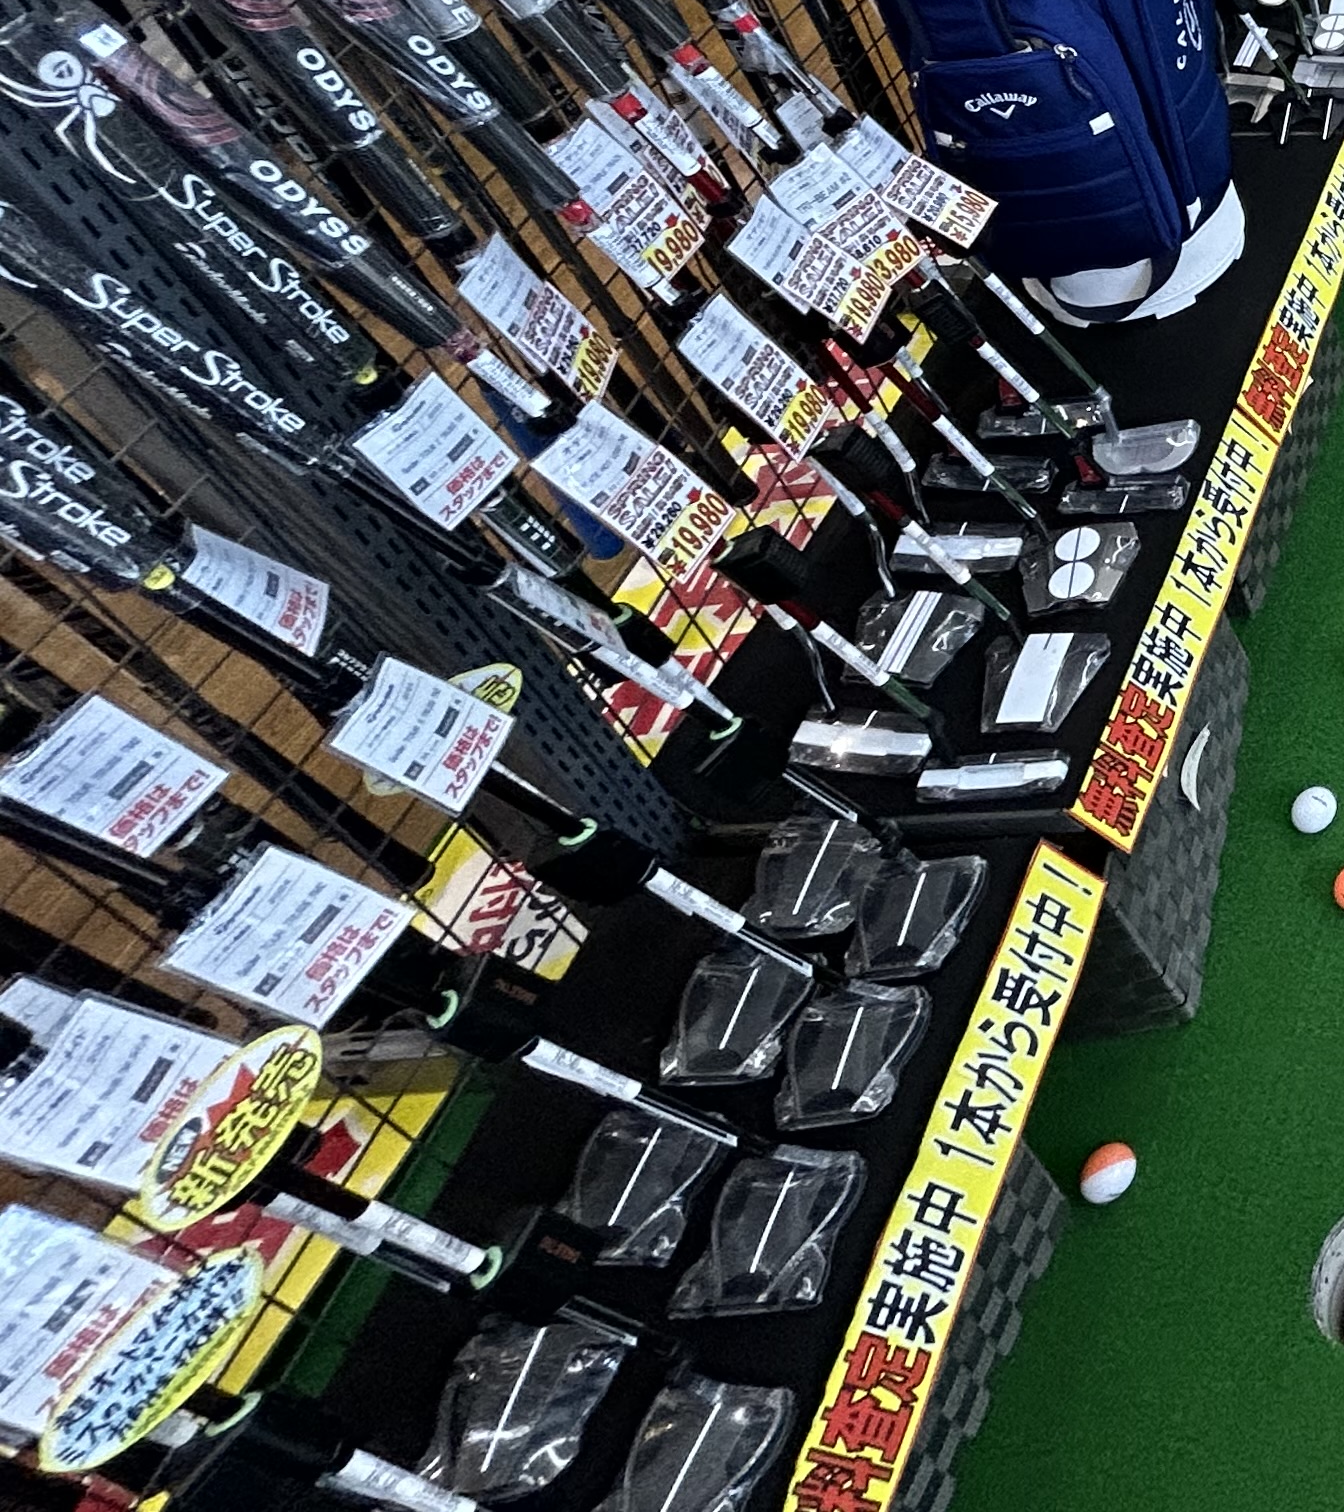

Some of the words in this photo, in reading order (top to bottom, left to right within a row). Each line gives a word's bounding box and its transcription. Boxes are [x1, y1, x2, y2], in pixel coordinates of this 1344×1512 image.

[963, 90, 1038, 115] Callaway
[1082, 602, 1195, 837] 無料査定実施中
[932, 860, 1097, 1168] 1本から受付中！
